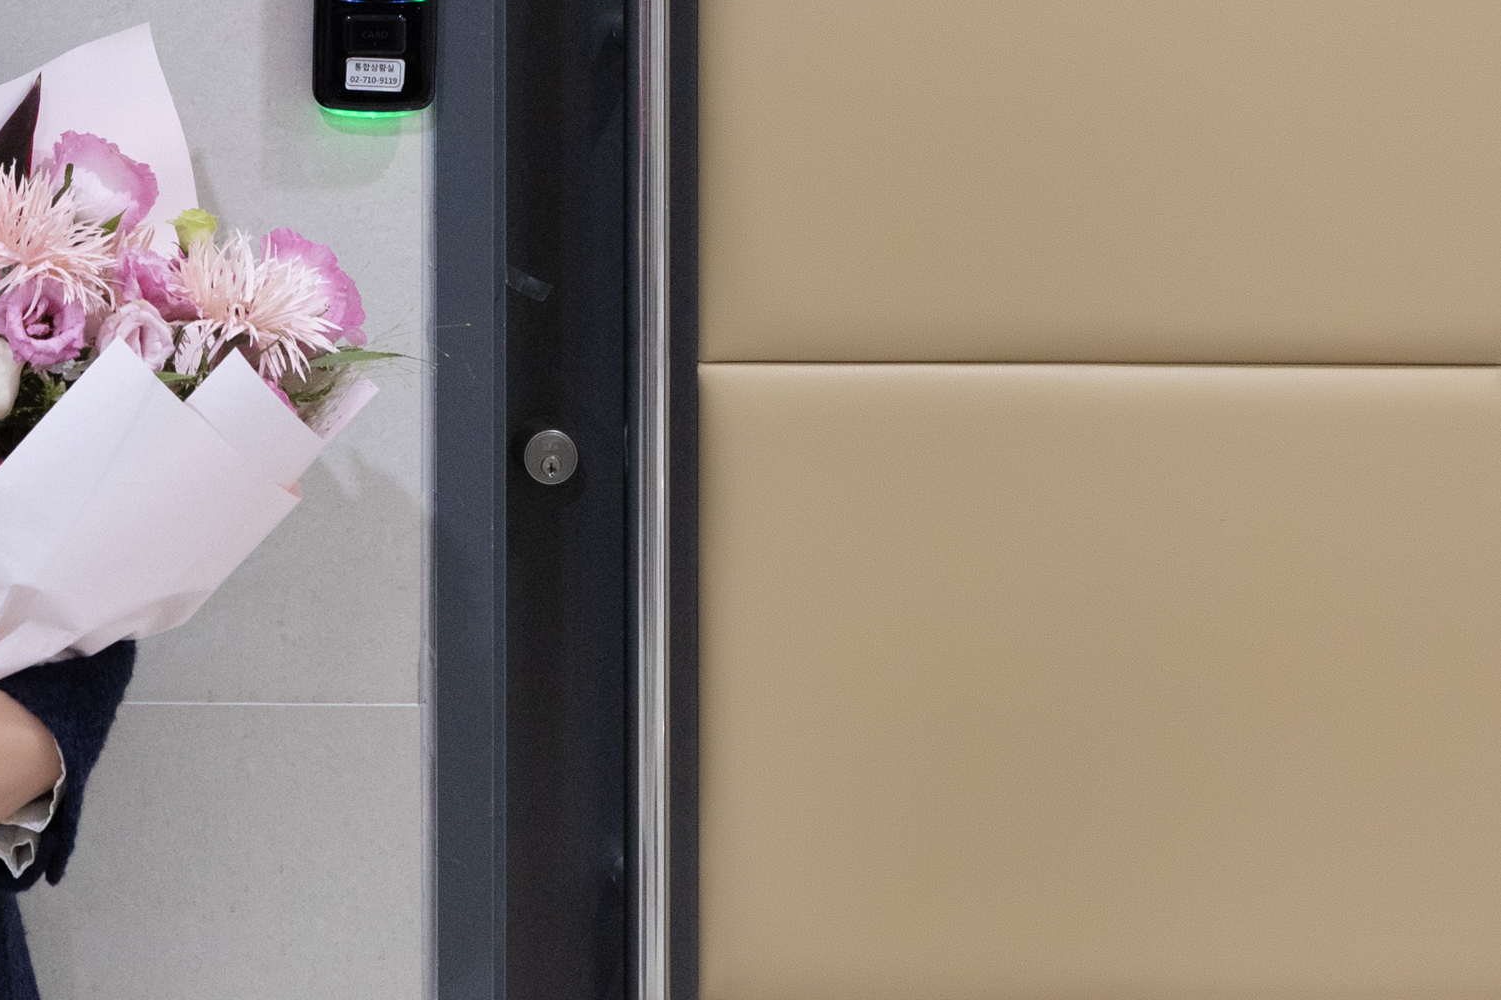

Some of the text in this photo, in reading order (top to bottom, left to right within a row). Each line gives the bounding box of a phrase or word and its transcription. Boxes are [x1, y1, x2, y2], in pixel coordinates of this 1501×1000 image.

[362, 30, 389, 39] CARD
[355, 62, 395, 73] 통합상황실
[349, 75, 398, 85] 02-710-9119
